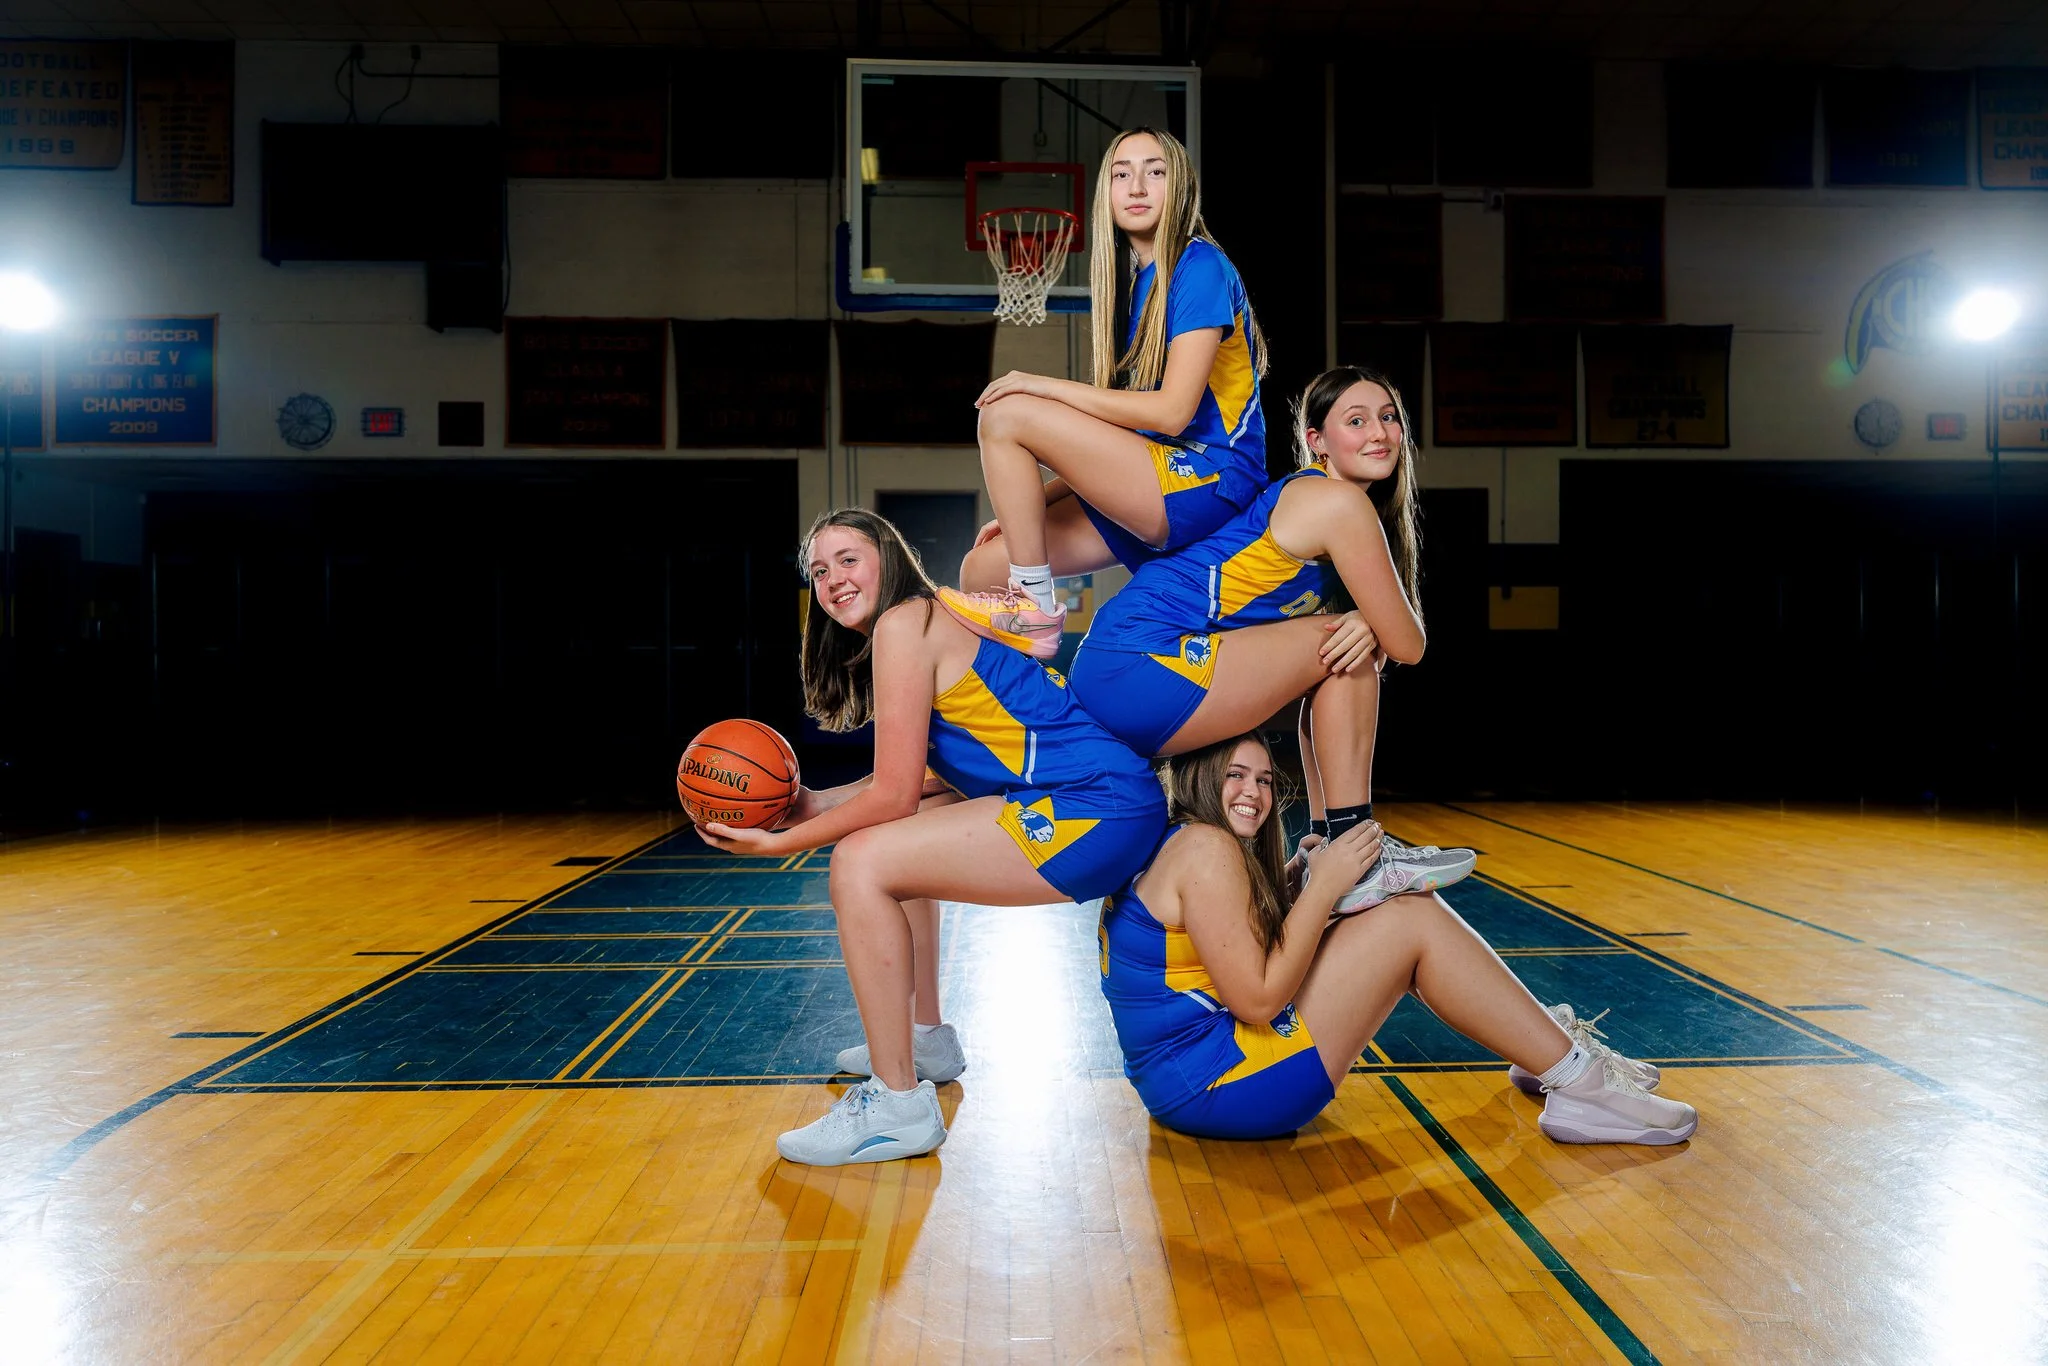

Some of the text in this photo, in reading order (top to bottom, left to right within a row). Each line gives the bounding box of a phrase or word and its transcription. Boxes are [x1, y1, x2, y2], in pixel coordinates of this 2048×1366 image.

[39, 108, 119, 128] CHAMPIONS
[125, 328, 199, 342] SOCCER
[88, 349, 181, 366] LEAGUE V
[82, 396, 187, 413] CHAMPIONS
[108, 420, 159, 434] 2009
[680, 756, 751, 794] SPALDING
